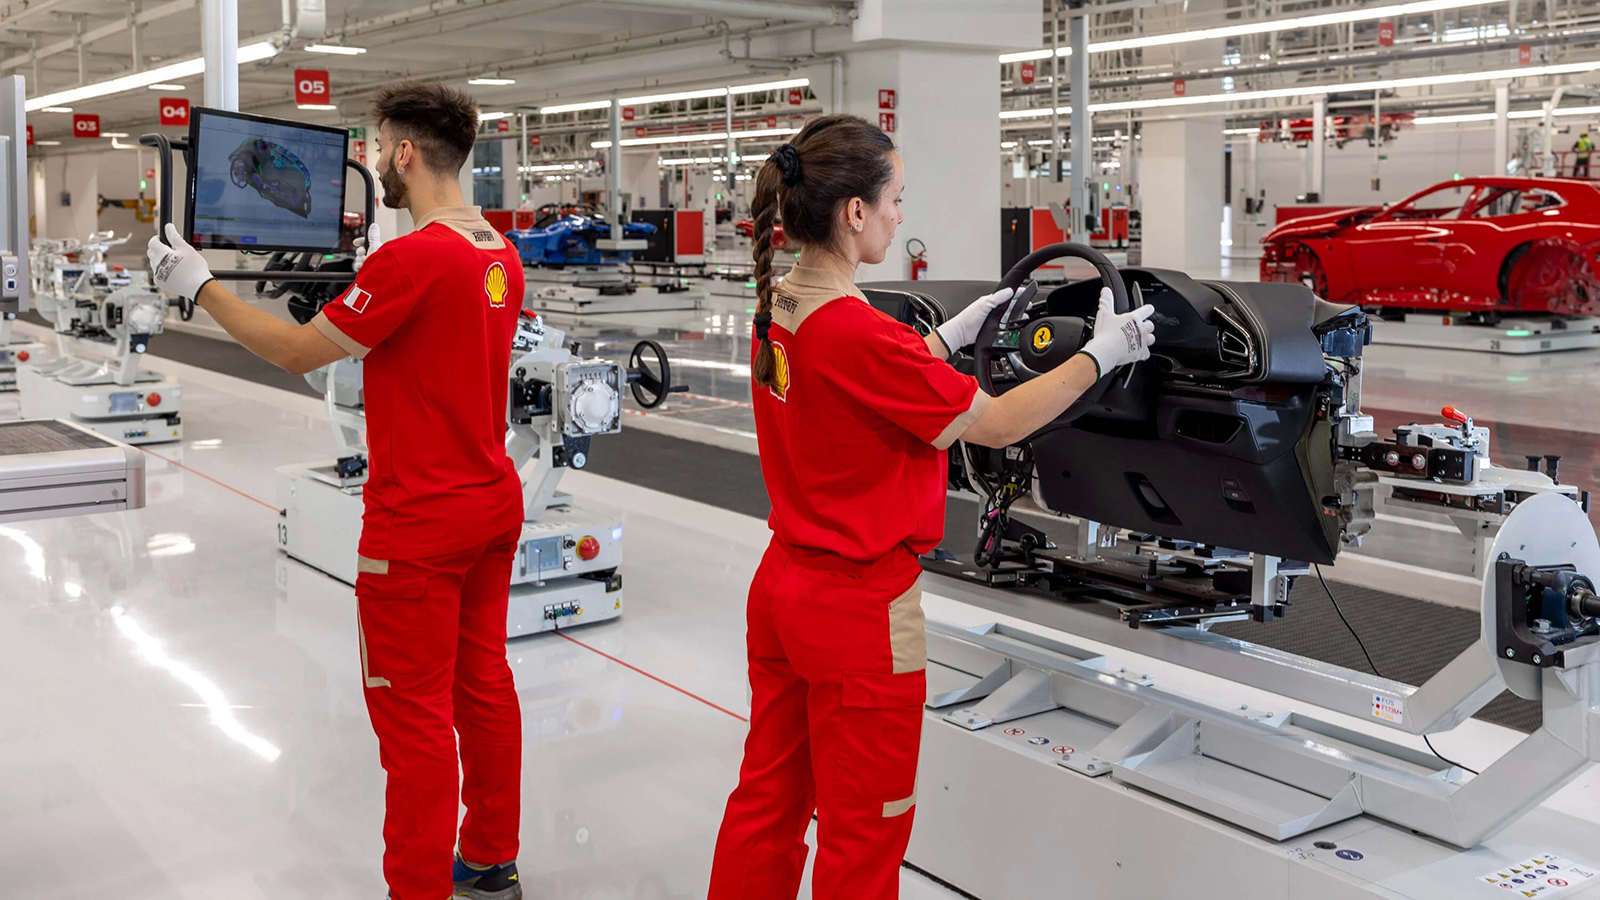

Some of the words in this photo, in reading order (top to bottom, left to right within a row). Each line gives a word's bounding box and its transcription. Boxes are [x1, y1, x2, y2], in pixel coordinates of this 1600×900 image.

[299, 80, 325, 94] 05
[162, 105, 187, 118] 04
[76, 120, 97, 131] 03
[472, 231, 495, 242] Ferrari
[774, 294, 799, 314] Ferrari
[277, 522, 287, 546] 13
